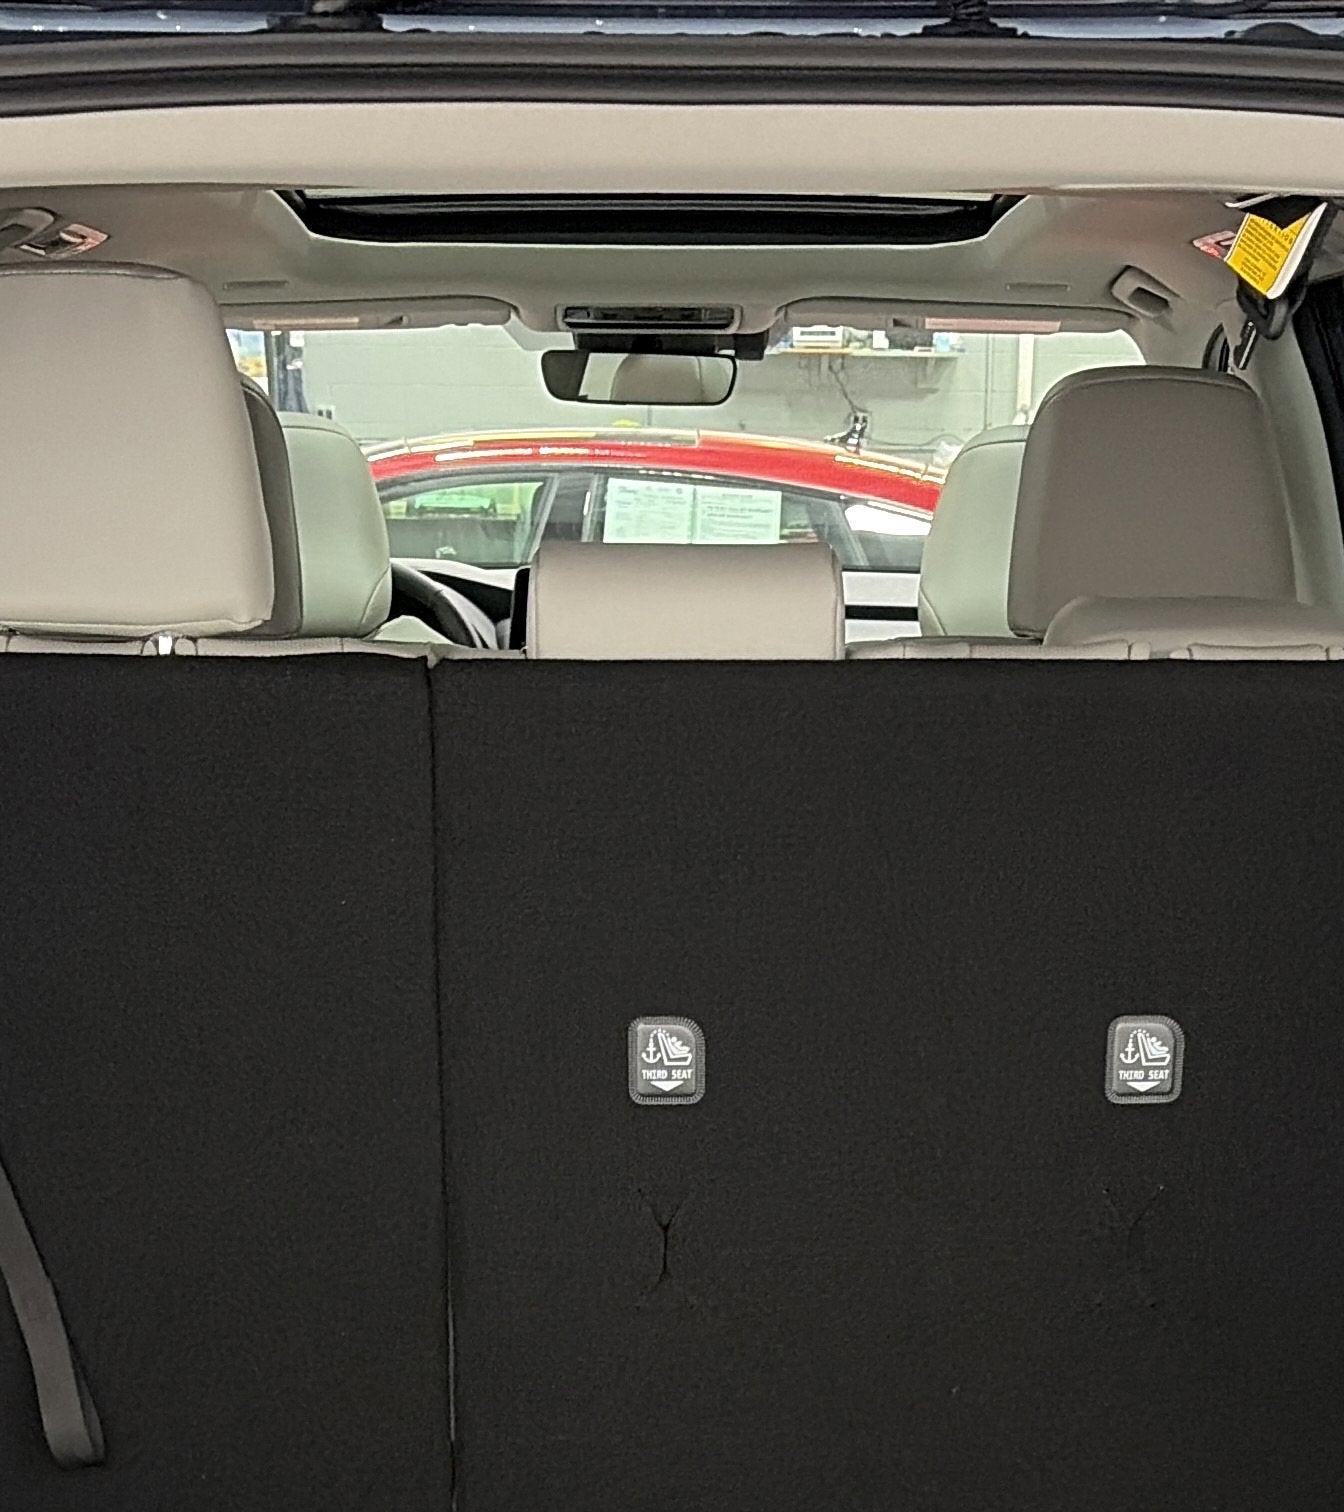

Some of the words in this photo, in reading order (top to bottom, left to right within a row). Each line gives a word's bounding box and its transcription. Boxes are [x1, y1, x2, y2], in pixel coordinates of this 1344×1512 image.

[641, 1068, 668, 1080] THIRD
[671, 1068, 694, 1080] SEAT
[1118, 1069, 1145, 1081] THIRD
[1147, 1069, 1170, 1080] SEAT
